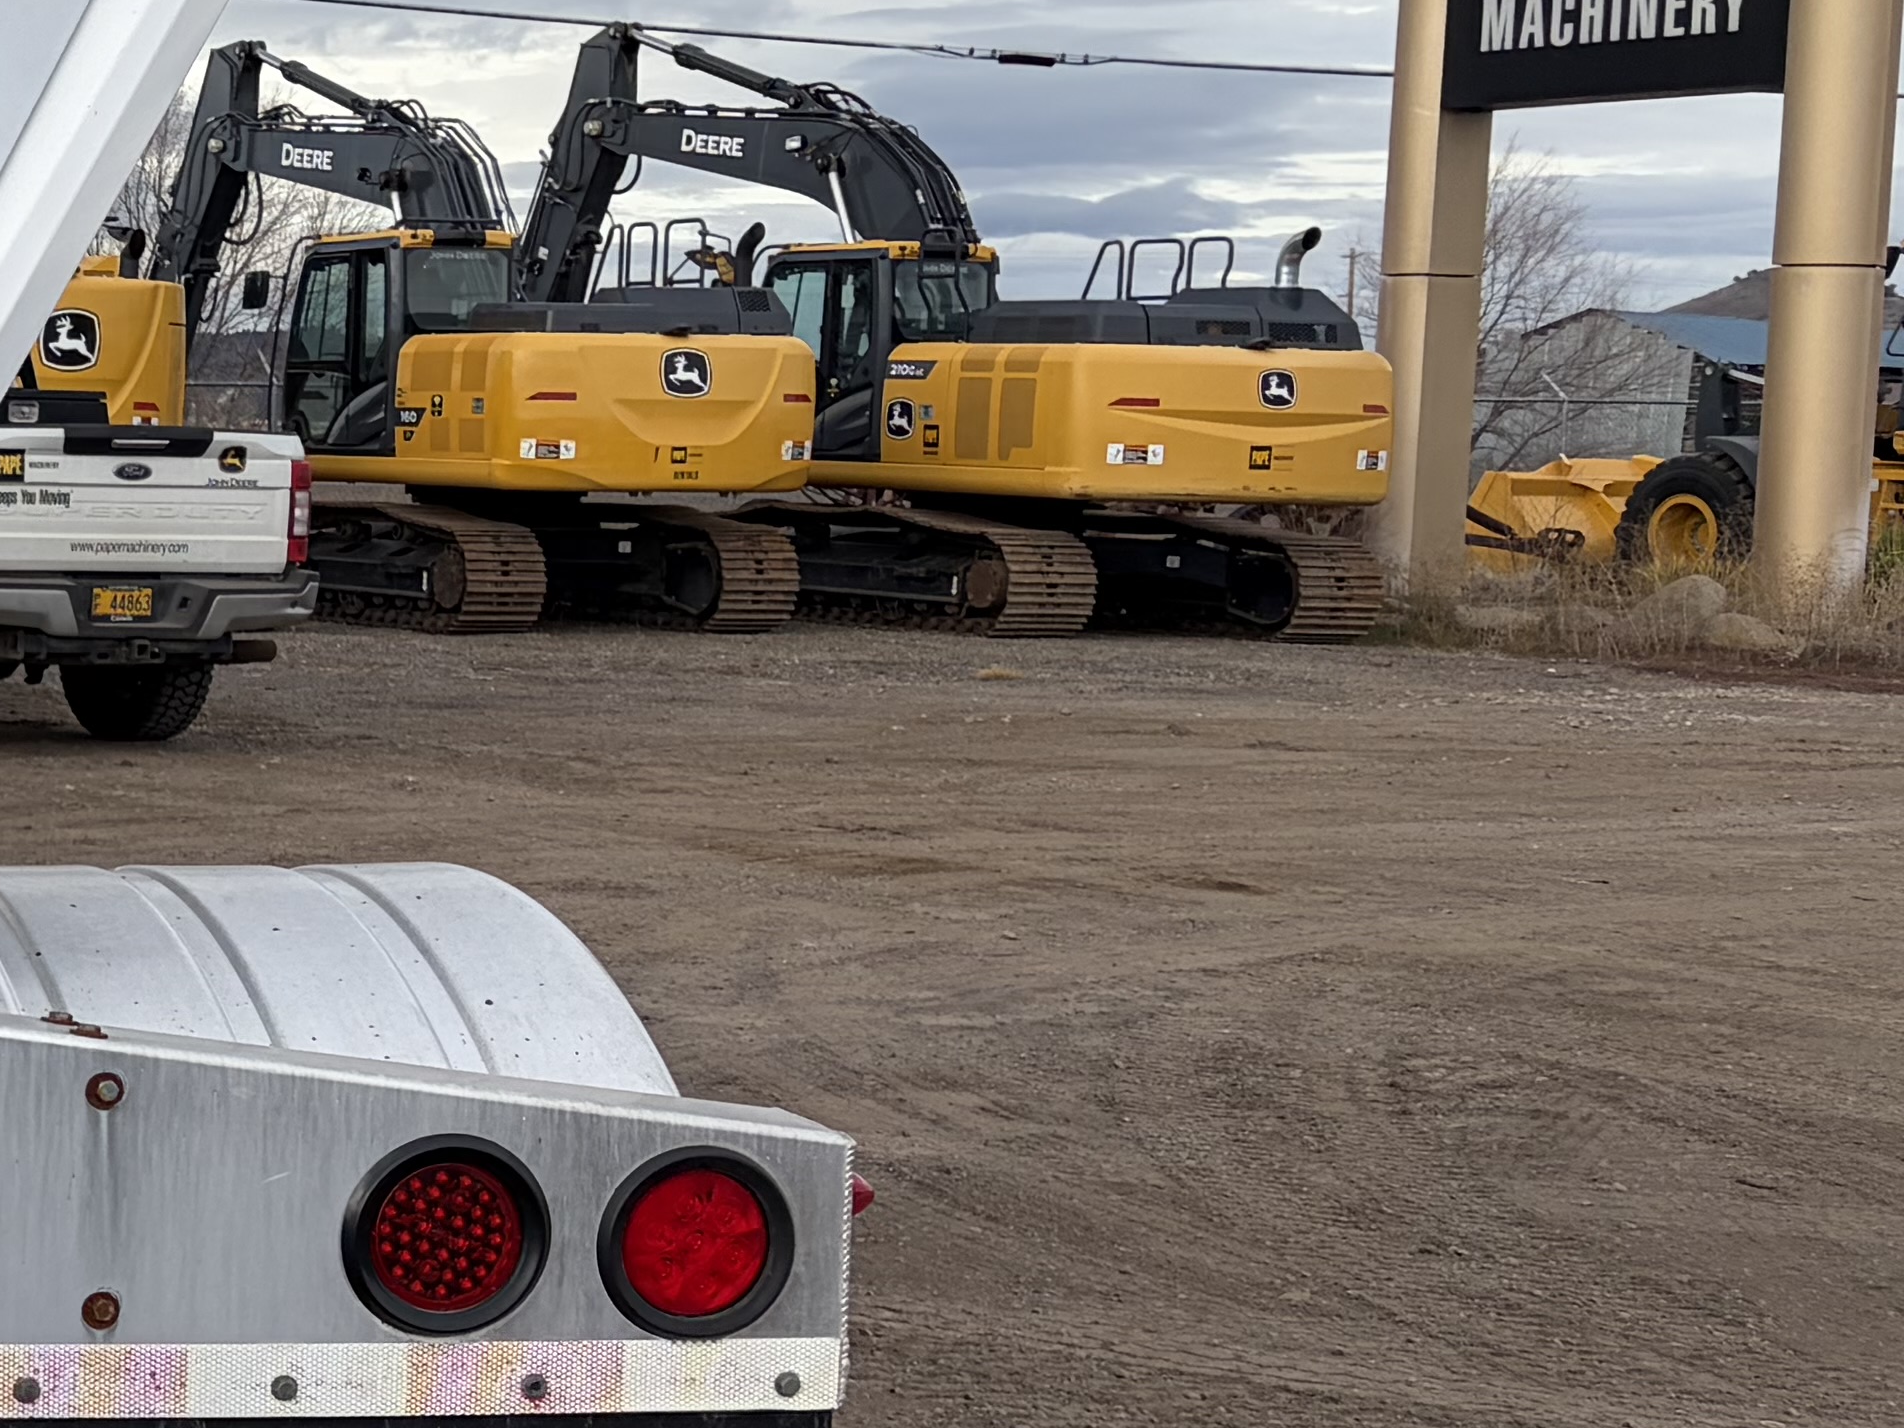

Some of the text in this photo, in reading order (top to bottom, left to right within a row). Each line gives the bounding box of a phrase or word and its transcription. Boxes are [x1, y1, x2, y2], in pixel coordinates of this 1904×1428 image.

[680, 128, 745, 158] DEERE
[281, 142, 334, 171] DEERE
[21, 489, 37, 505] You
[109, 593, 151, 613] 44863
